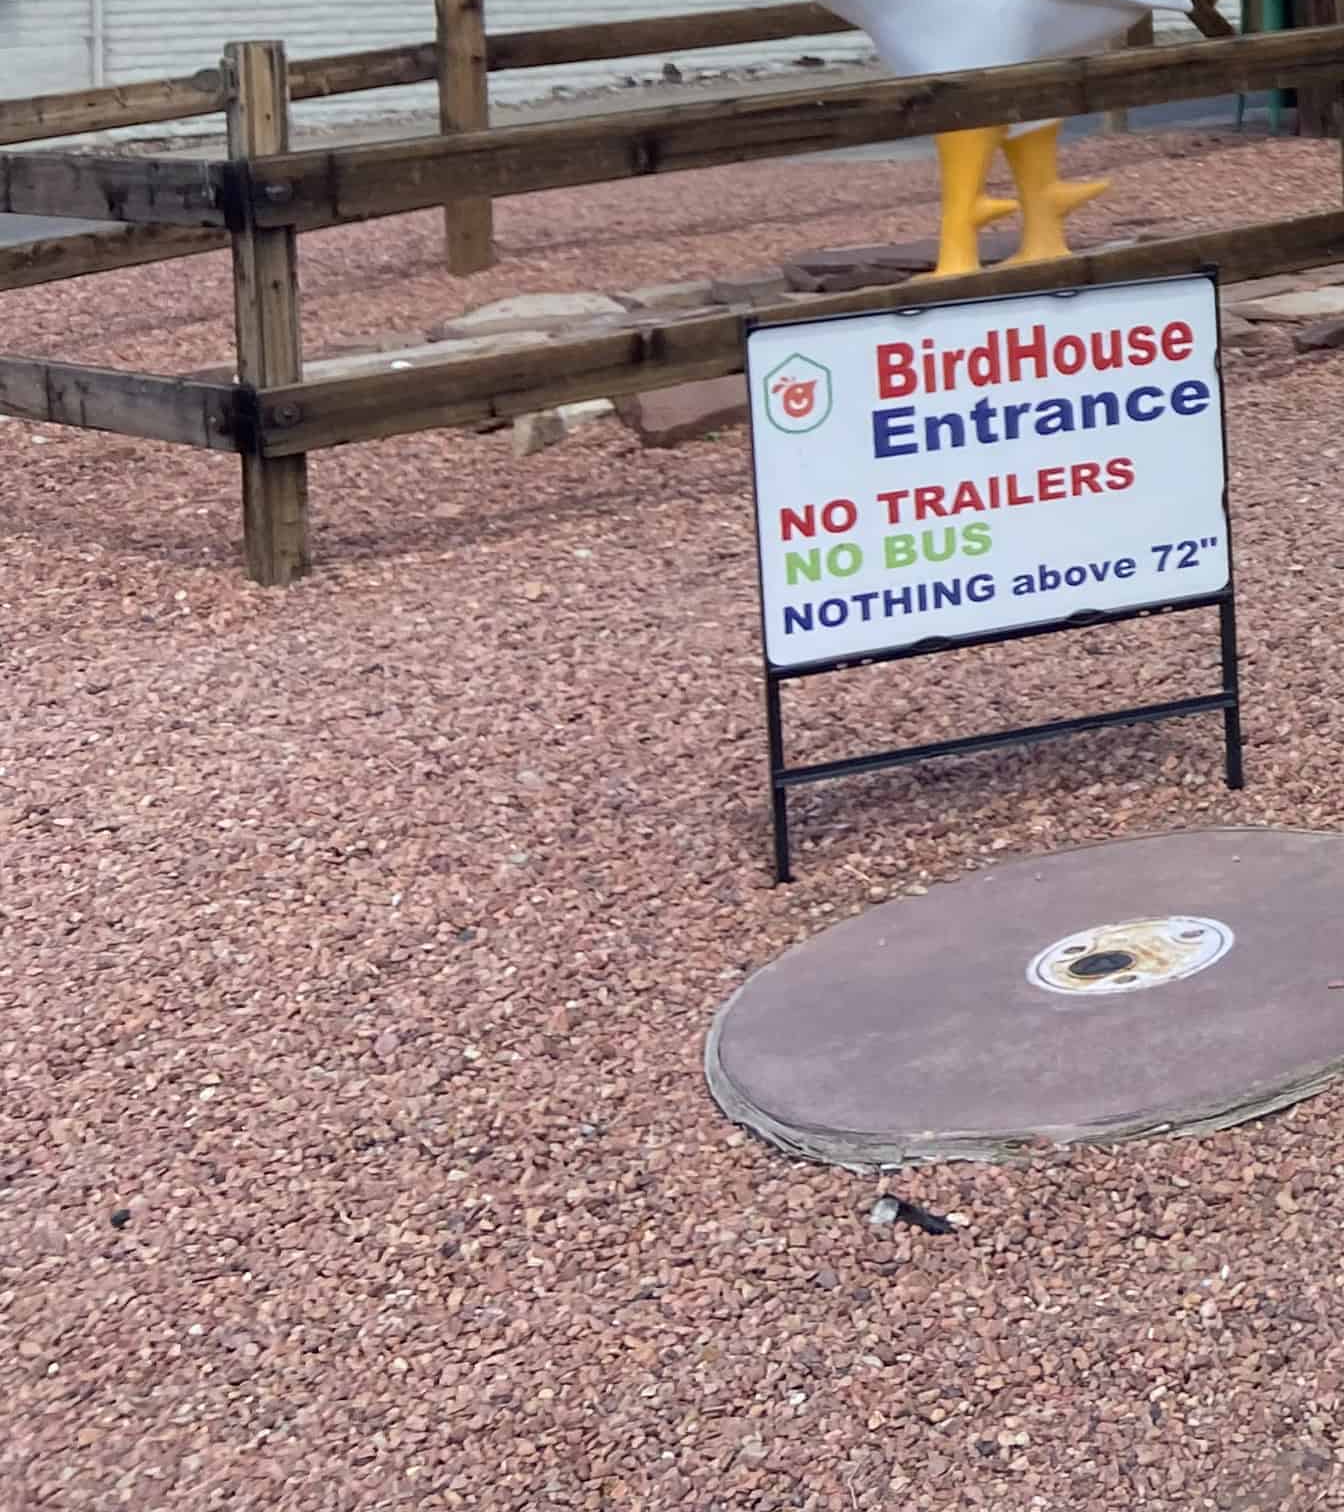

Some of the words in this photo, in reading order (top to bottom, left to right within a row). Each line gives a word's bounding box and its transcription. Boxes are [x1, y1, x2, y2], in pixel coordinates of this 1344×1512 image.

[875, 319, 1194, 400] BirdHouse
[871, 377, 1211, 458] Entrance
[779, 498, 858, 541] NO
[876, 456, 1136, 526] TRAILERS
[783, 573, 996, 635] NOTHING
[1011, 555, 1137, 597] above
[1150, 535, 1220, 573] 72"
[784, 541, 864, 586] NO
[883, 521, 993, 570] BUS
